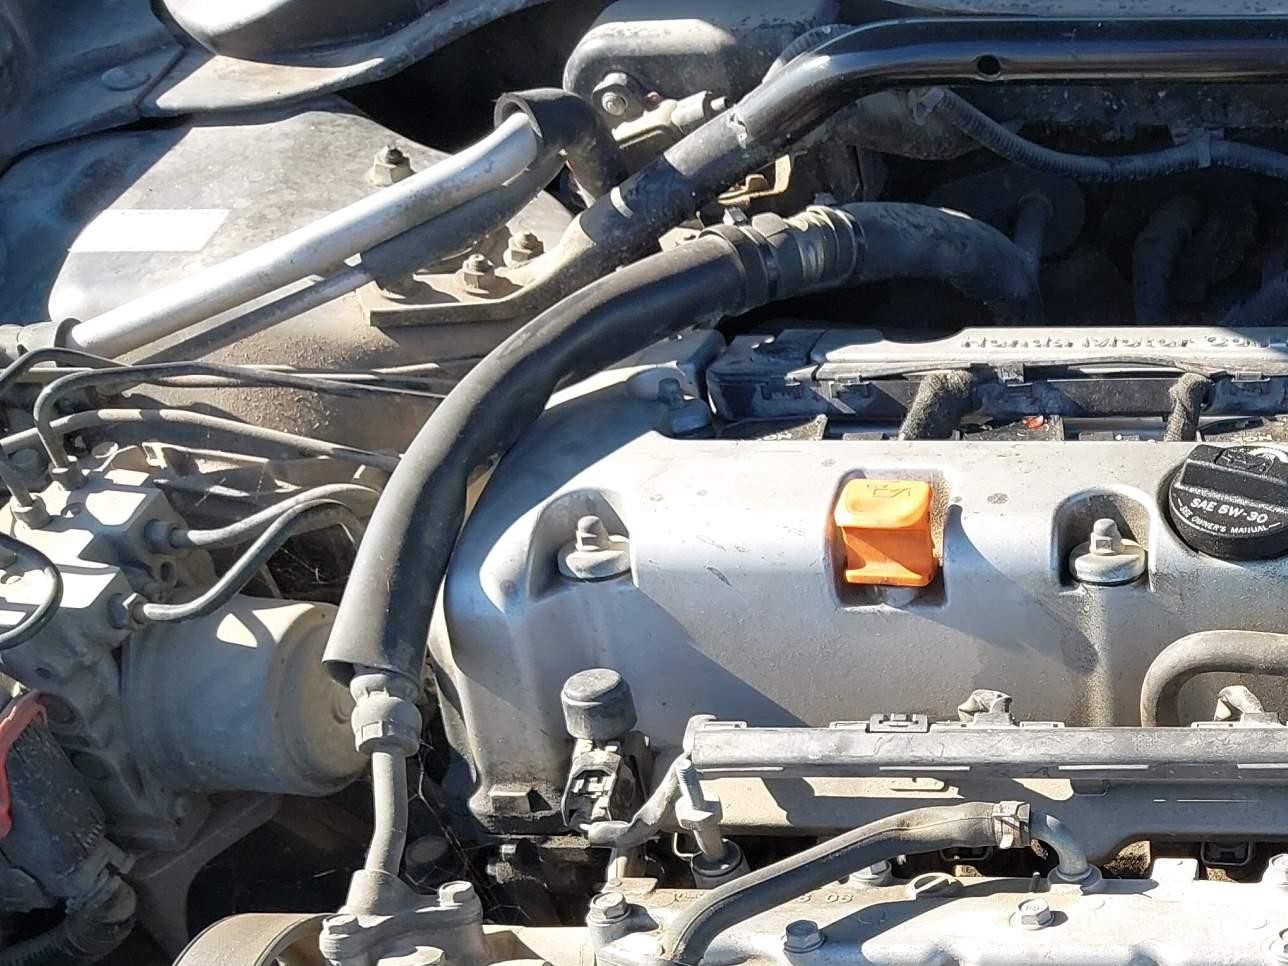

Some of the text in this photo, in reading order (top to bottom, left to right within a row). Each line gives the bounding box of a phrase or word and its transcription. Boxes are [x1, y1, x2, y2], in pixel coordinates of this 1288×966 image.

[1190, 498, 1268, 524] SAE 5W-30
[1191, 516, 1227, 533] OWNER'S
[1230, 524, 1269, 534] MANUAL
